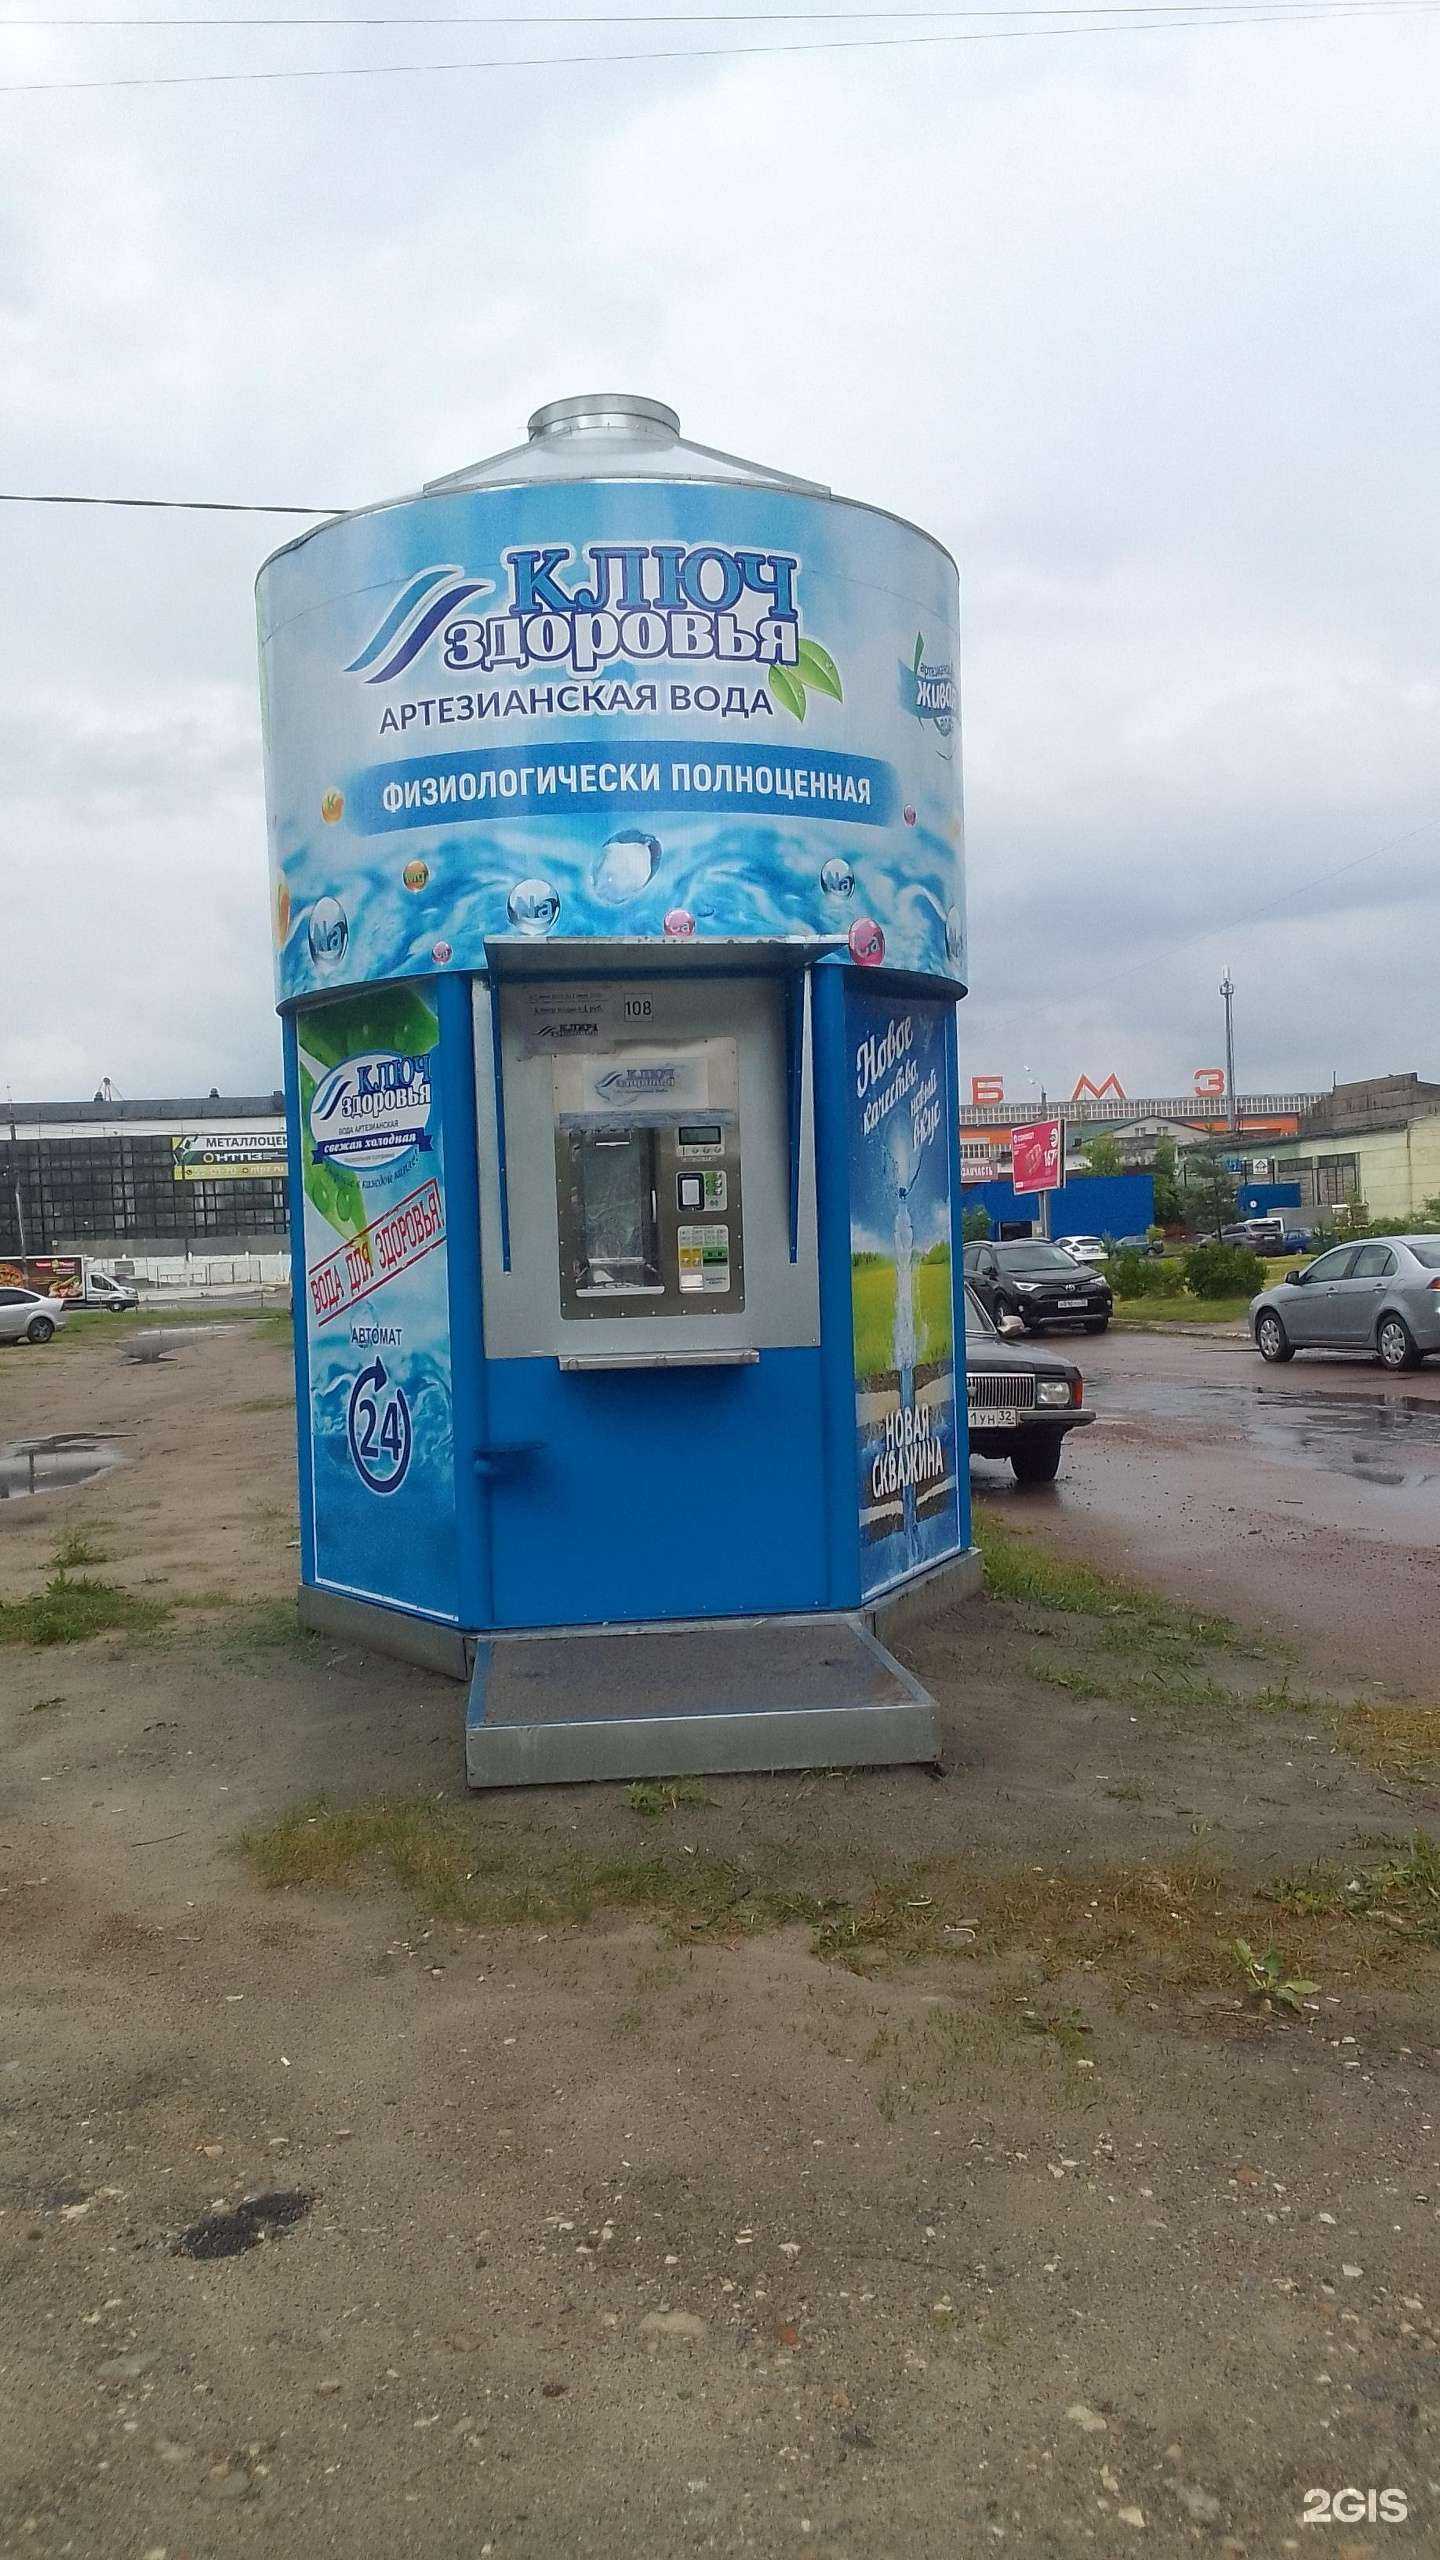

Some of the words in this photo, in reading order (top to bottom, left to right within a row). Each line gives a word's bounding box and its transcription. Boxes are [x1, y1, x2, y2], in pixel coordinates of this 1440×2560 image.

[507, 545, 799, 620] КЛЮЧ
[379, 683, 658, 735] АРТЕЗИАНСКАЯ
[674, 685, 774, 719] ВОДА
[381, 762, 661, 814] ФИЗИОЛОГИЧЕСКИ
[671, 763, 872, 806] ПОЛНОЦЕННАЯ
[625, 1000, 652, 1016] 108
[856, 1015, 914, 1098] Новое
[310, 1265, 345, 1315] ВОДА
[345, 1242, 374, 1296] ДЛЯ
[351, 1327, 402, 1346] АВТОМАТ
[359, 1400, 403, 1461] 24
[885, 1403, 930, 1450] НОВАЯ
[872, 1436, 944, 1498] СКВАЖИНА
